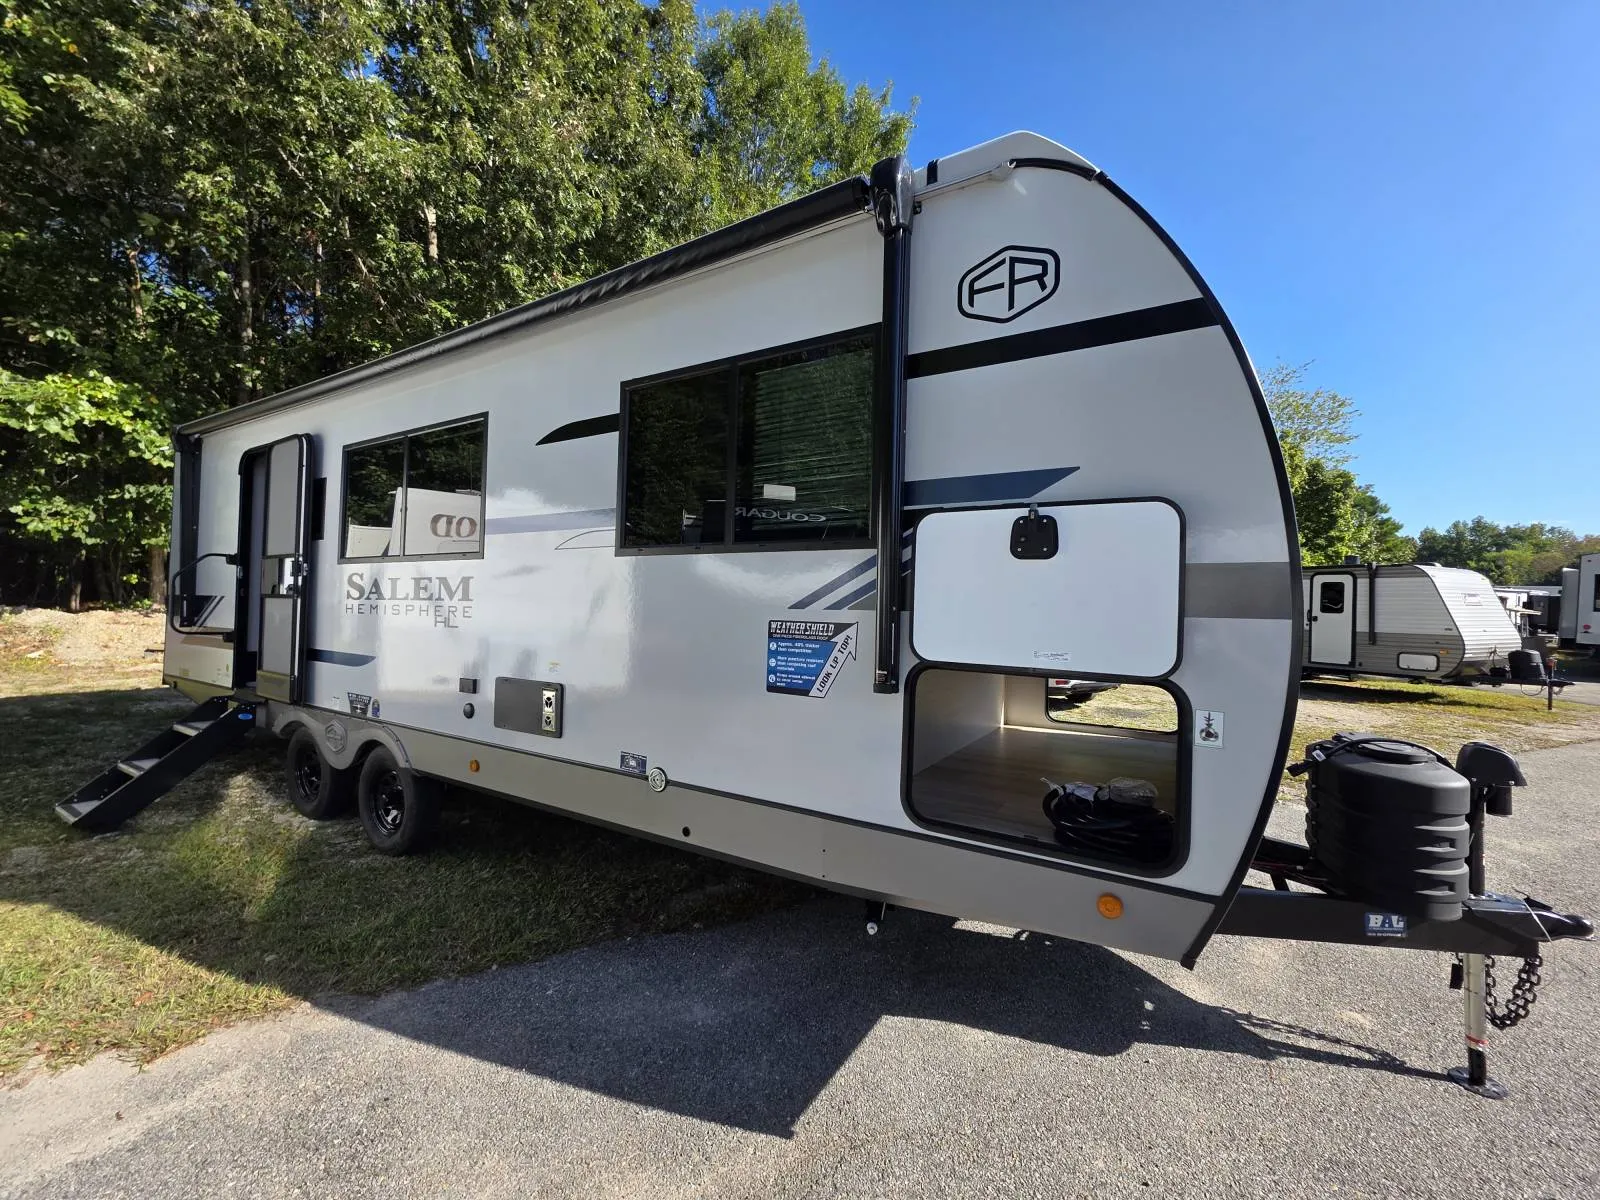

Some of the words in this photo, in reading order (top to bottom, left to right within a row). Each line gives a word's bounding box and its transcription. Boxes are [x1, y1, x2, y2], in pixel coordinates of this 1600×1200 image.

[967, 255, 1048, 312] FR
[346, 572, 475, 602] SALEM
[345, 603, 473, 618] HEMISPHERE
[816, 670, 833, 693] LOOK
[829, 655, 840, 670] UP
[838, 634, 853, 655] TOP!
